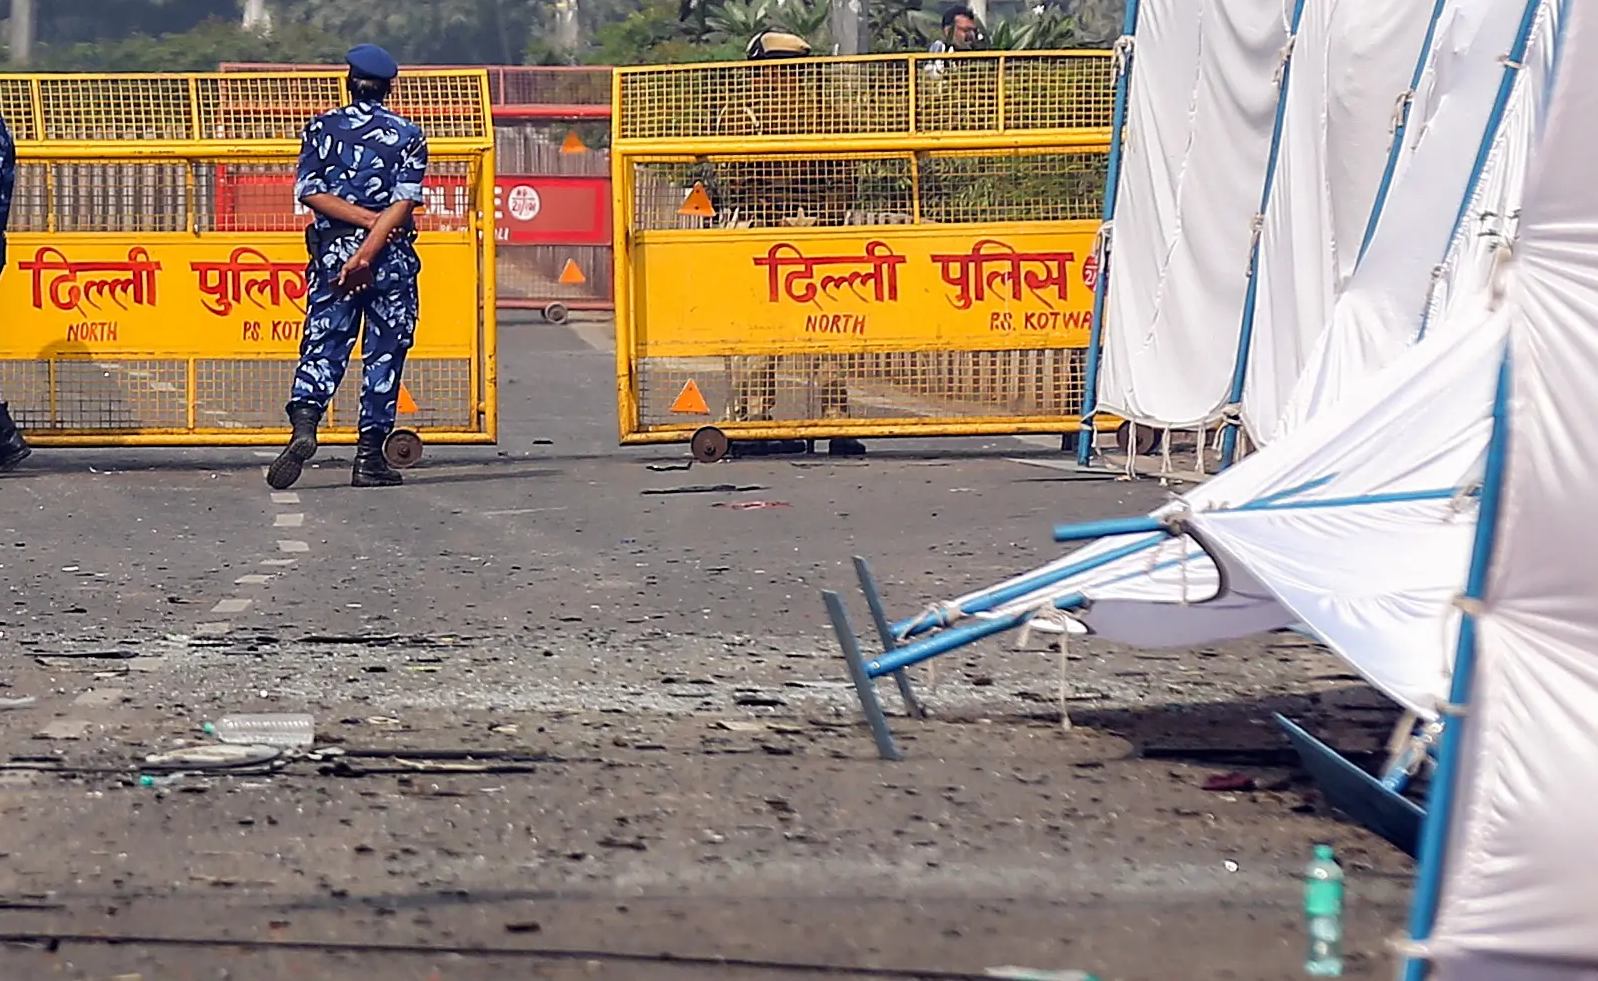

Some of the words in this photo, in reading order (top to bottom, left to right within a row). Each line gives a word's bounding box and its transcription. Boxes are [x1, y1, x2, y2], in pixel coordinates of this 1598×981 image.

[18, 247, 162, 318] दिल्ली
[752, 240, 906, 312] दिल्ली
[931, 239, 1075, 311] पुलिस
[67, 321, 118, 343] NORTH
[805, 314, 866, 336] NORTH
[1024, 311, 1093, 331] KOTWA
